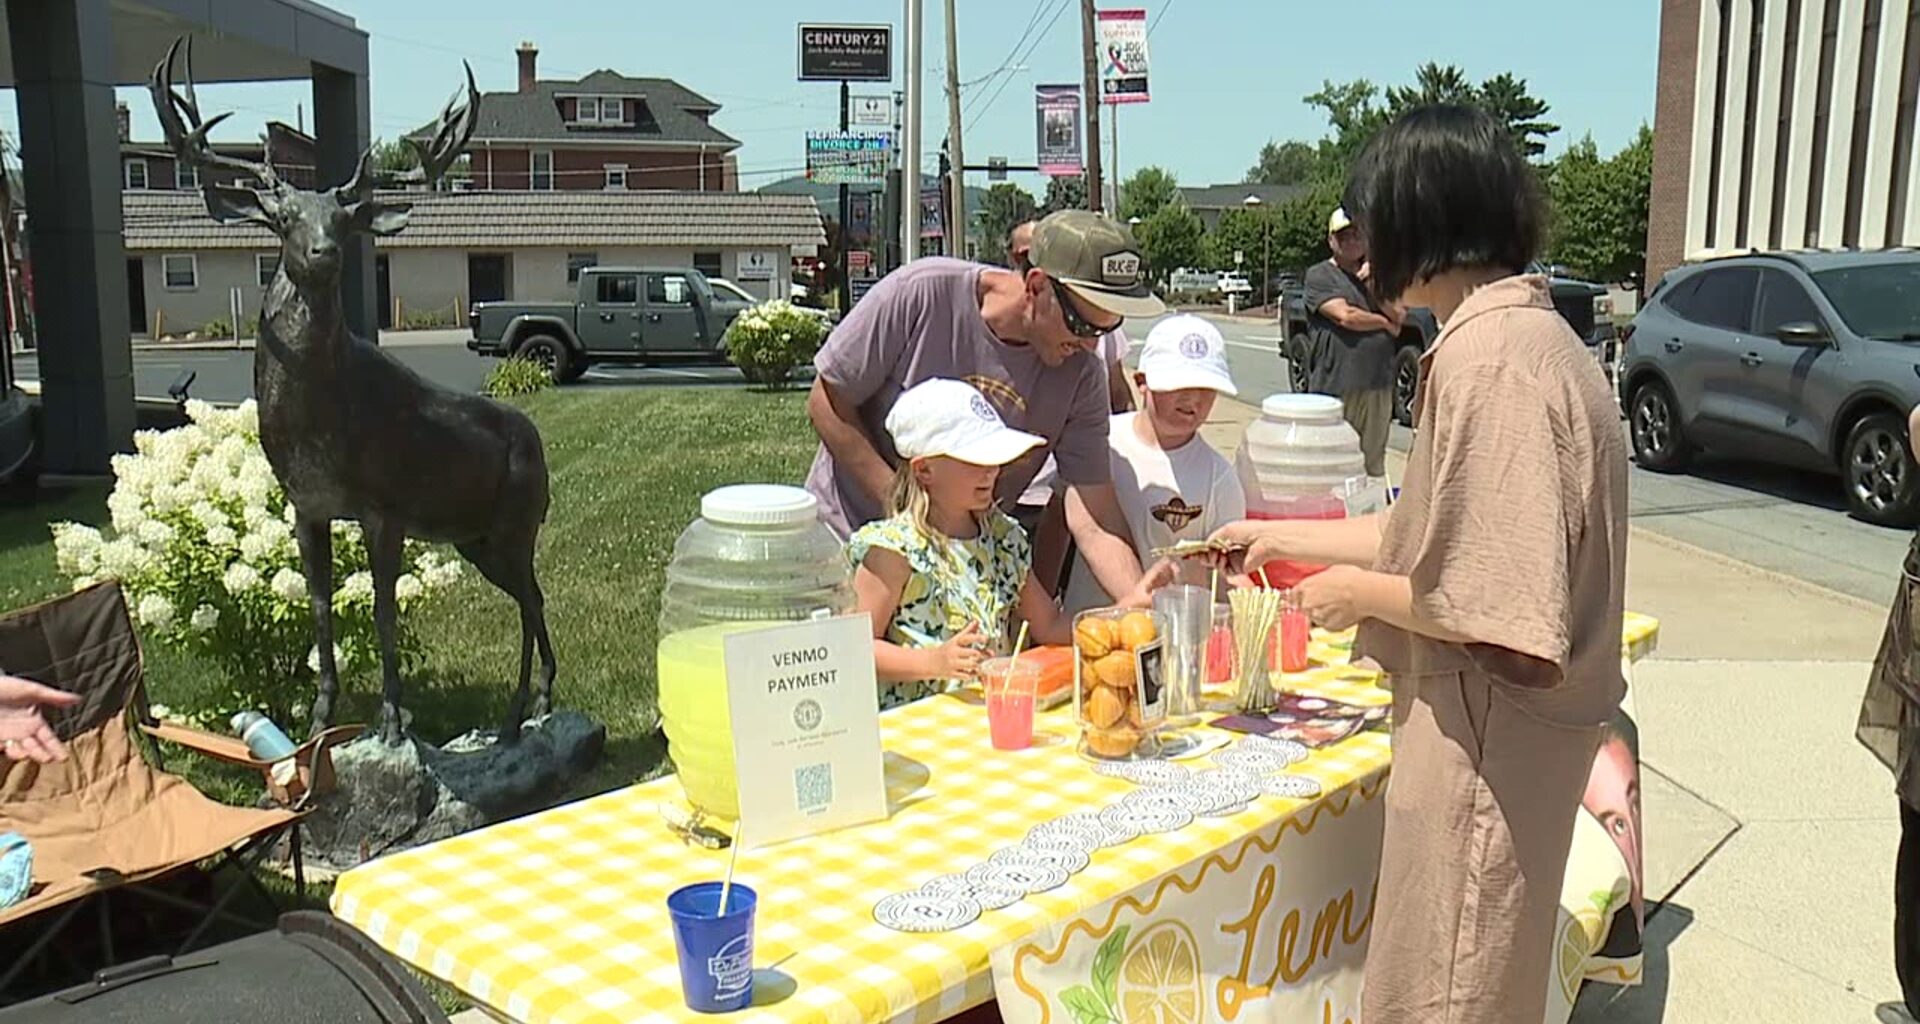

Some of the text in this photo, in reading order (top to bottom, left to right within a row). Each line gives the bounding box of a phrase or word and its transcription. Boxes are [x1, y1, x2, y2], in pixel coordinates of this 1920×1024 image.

[805, 32, 886, 47] CENTURY 21
[808, 129, 887, 140] REFINANCING
[810, 139, 861, 150] DIVORCE
[772, 646, 829, 667] VENMO
[767, 670, 838, 693] PAYMENT
